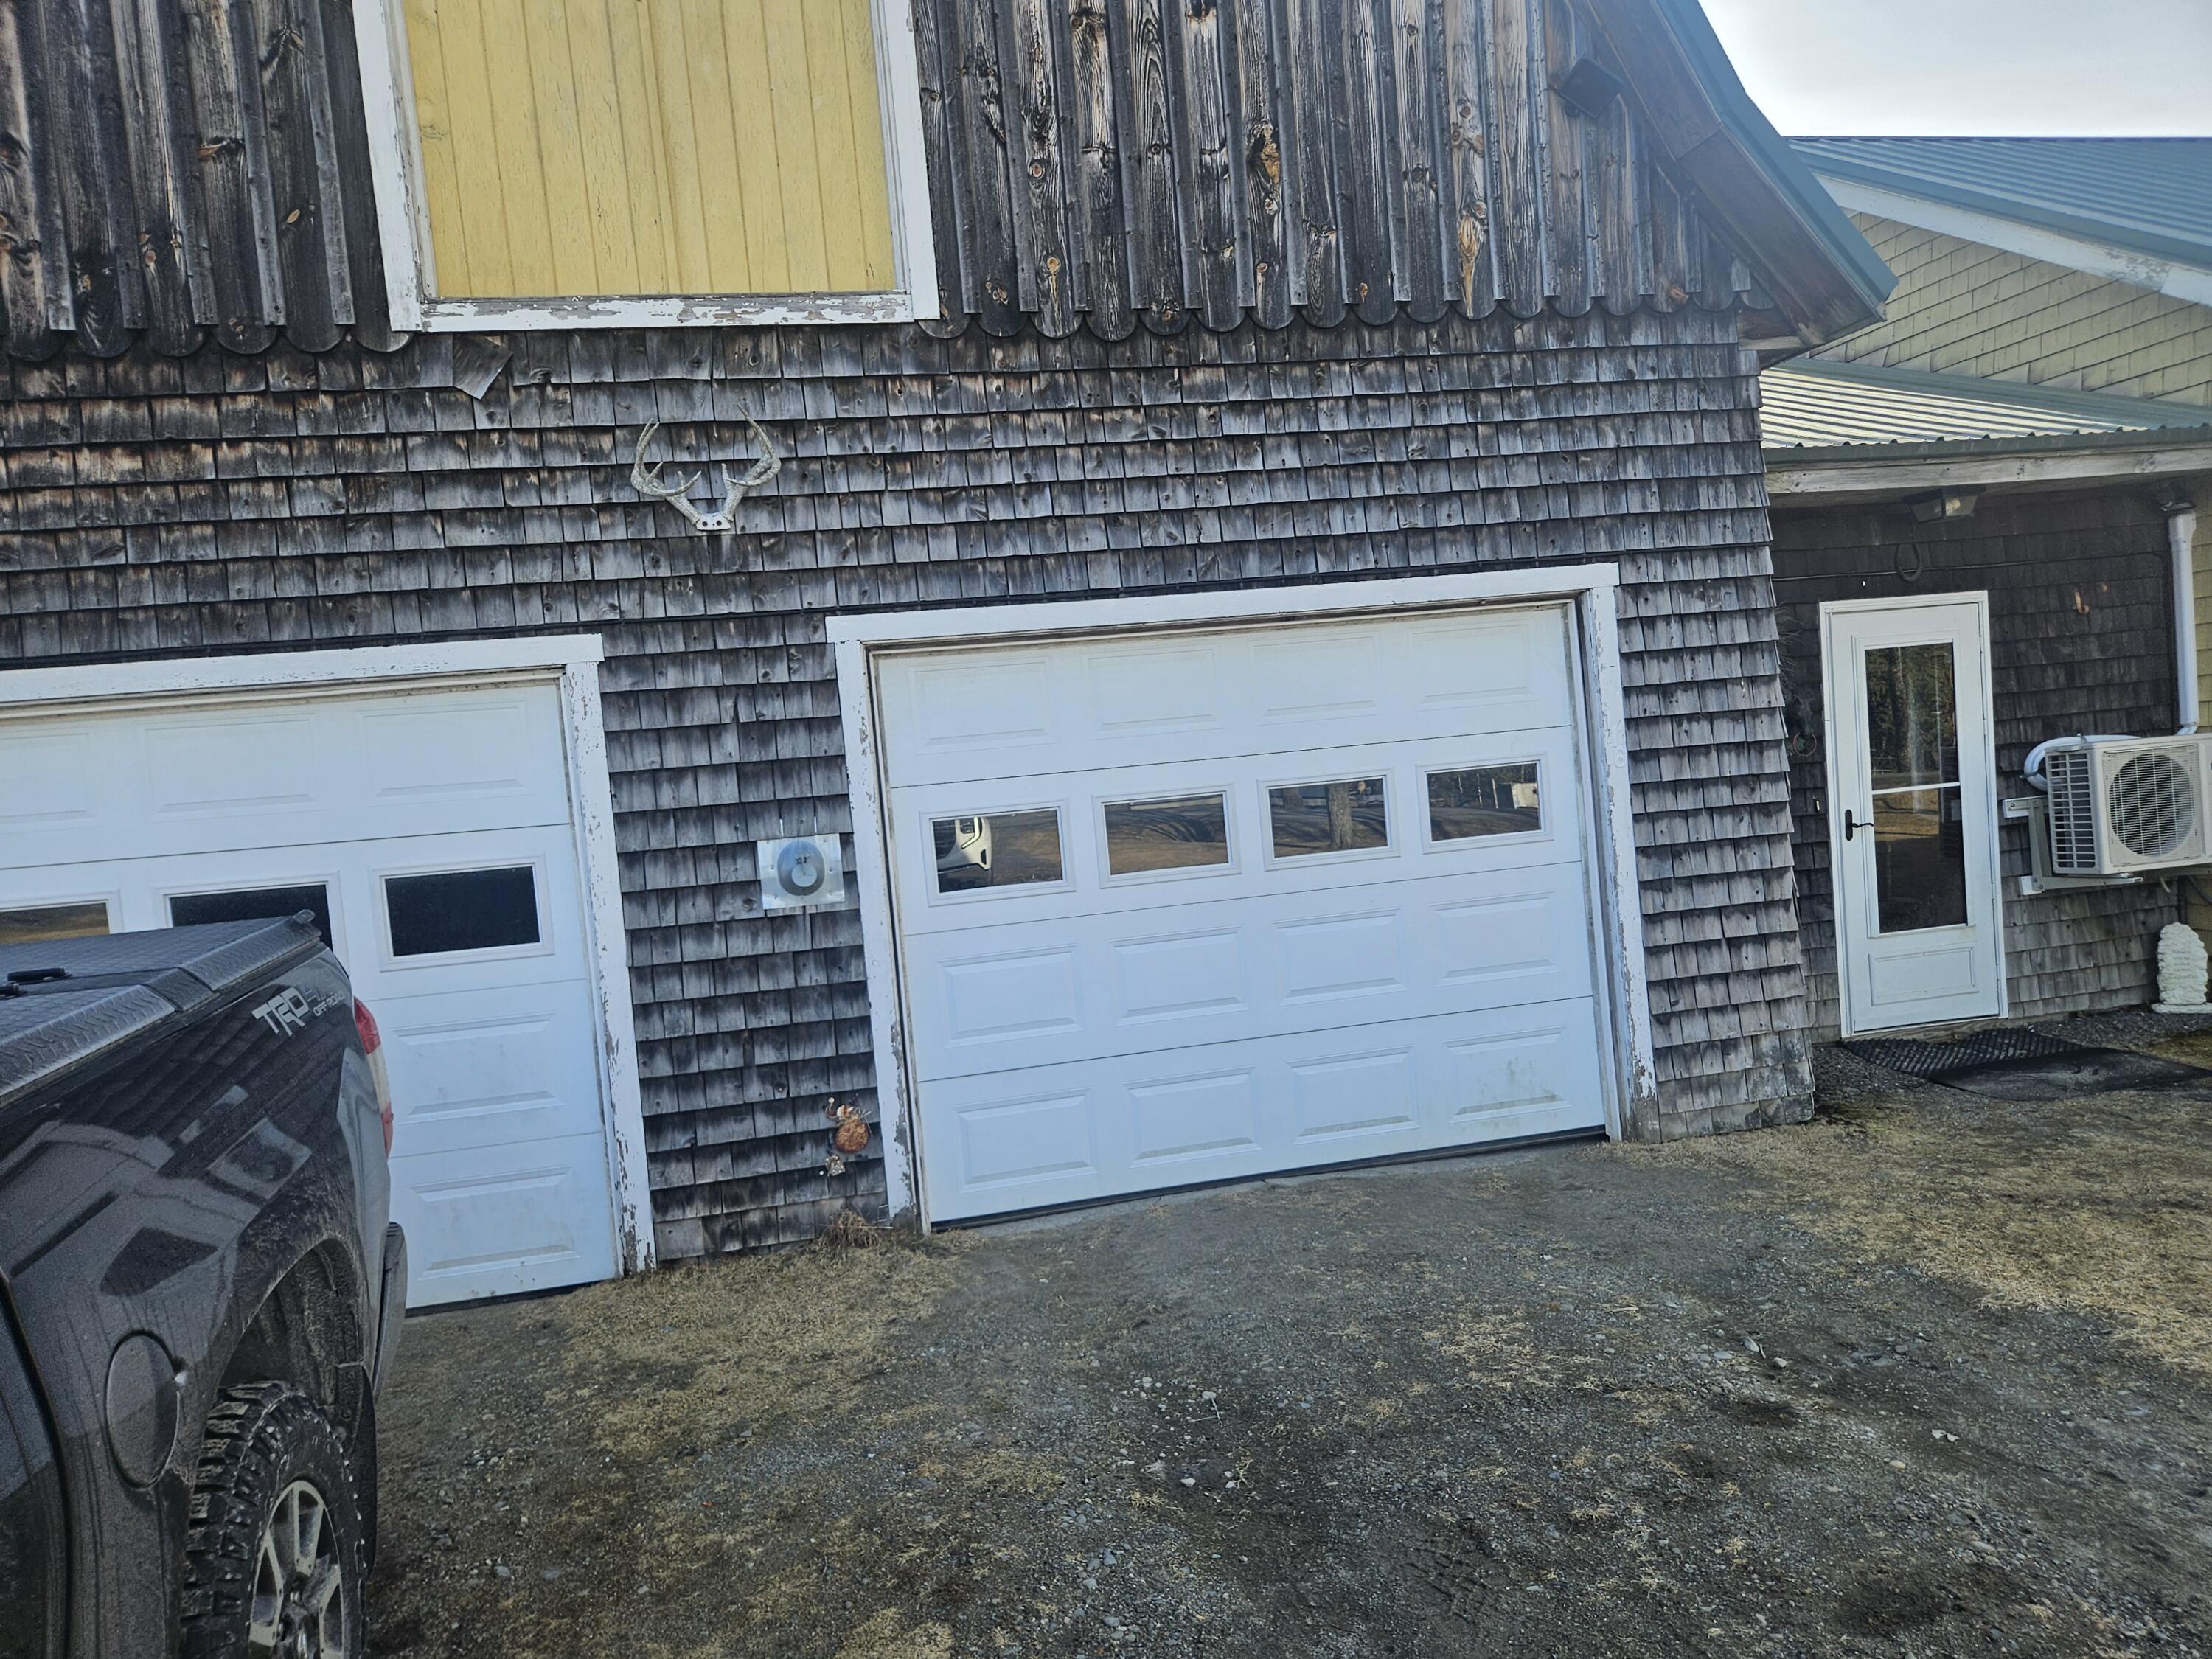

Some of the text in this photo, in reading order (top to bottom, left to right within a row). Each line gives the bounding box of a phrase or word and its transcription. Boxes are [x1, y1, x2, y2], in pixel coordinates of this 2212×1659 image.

[251, 987, 310, 1037] TRD
[313, 1001, 327, 1017] OFF
[326, 990, 346, 1008] ROAD
